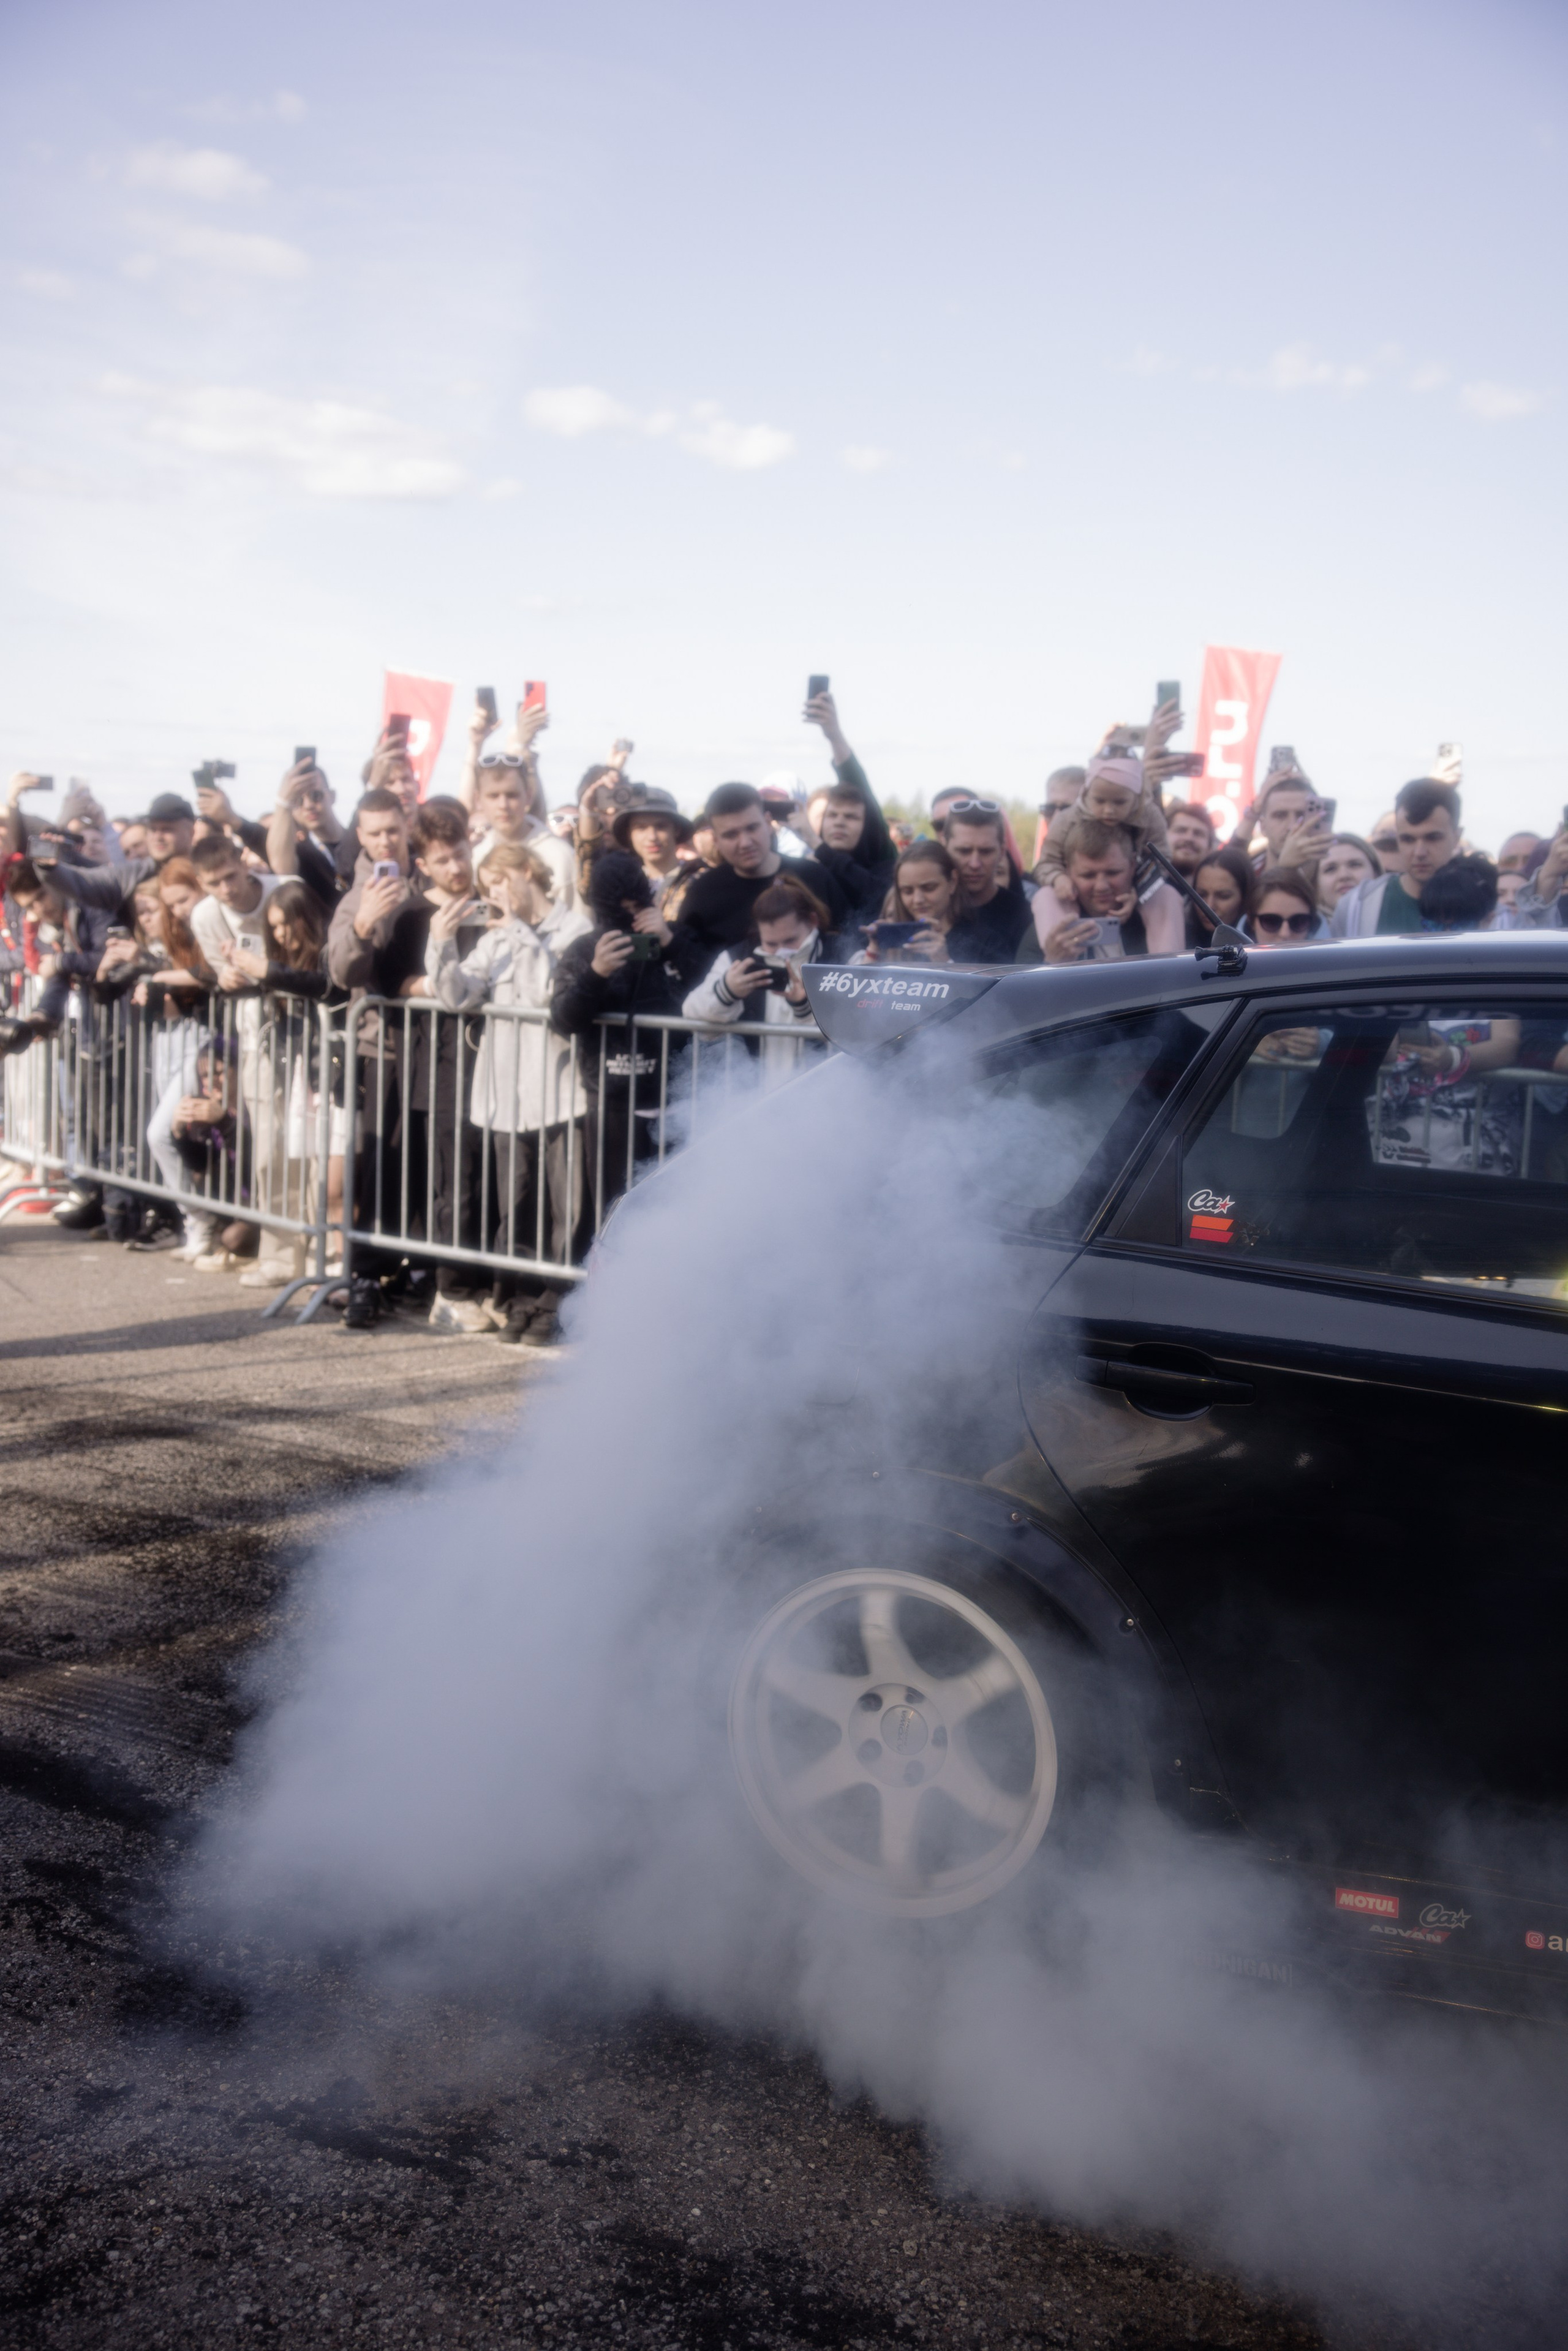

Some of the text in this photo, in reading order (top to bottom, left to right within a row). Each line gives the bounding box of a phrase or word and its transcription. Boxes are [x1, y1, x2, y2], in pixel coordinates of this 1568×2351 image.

[857, 998, 921, 1011] drift team
[1339, 1892, 1395, 1913] MOTUL
[1368, 1925, 1442, 1943] ADVAN
[1548, 1935, 1568, 1953] a
